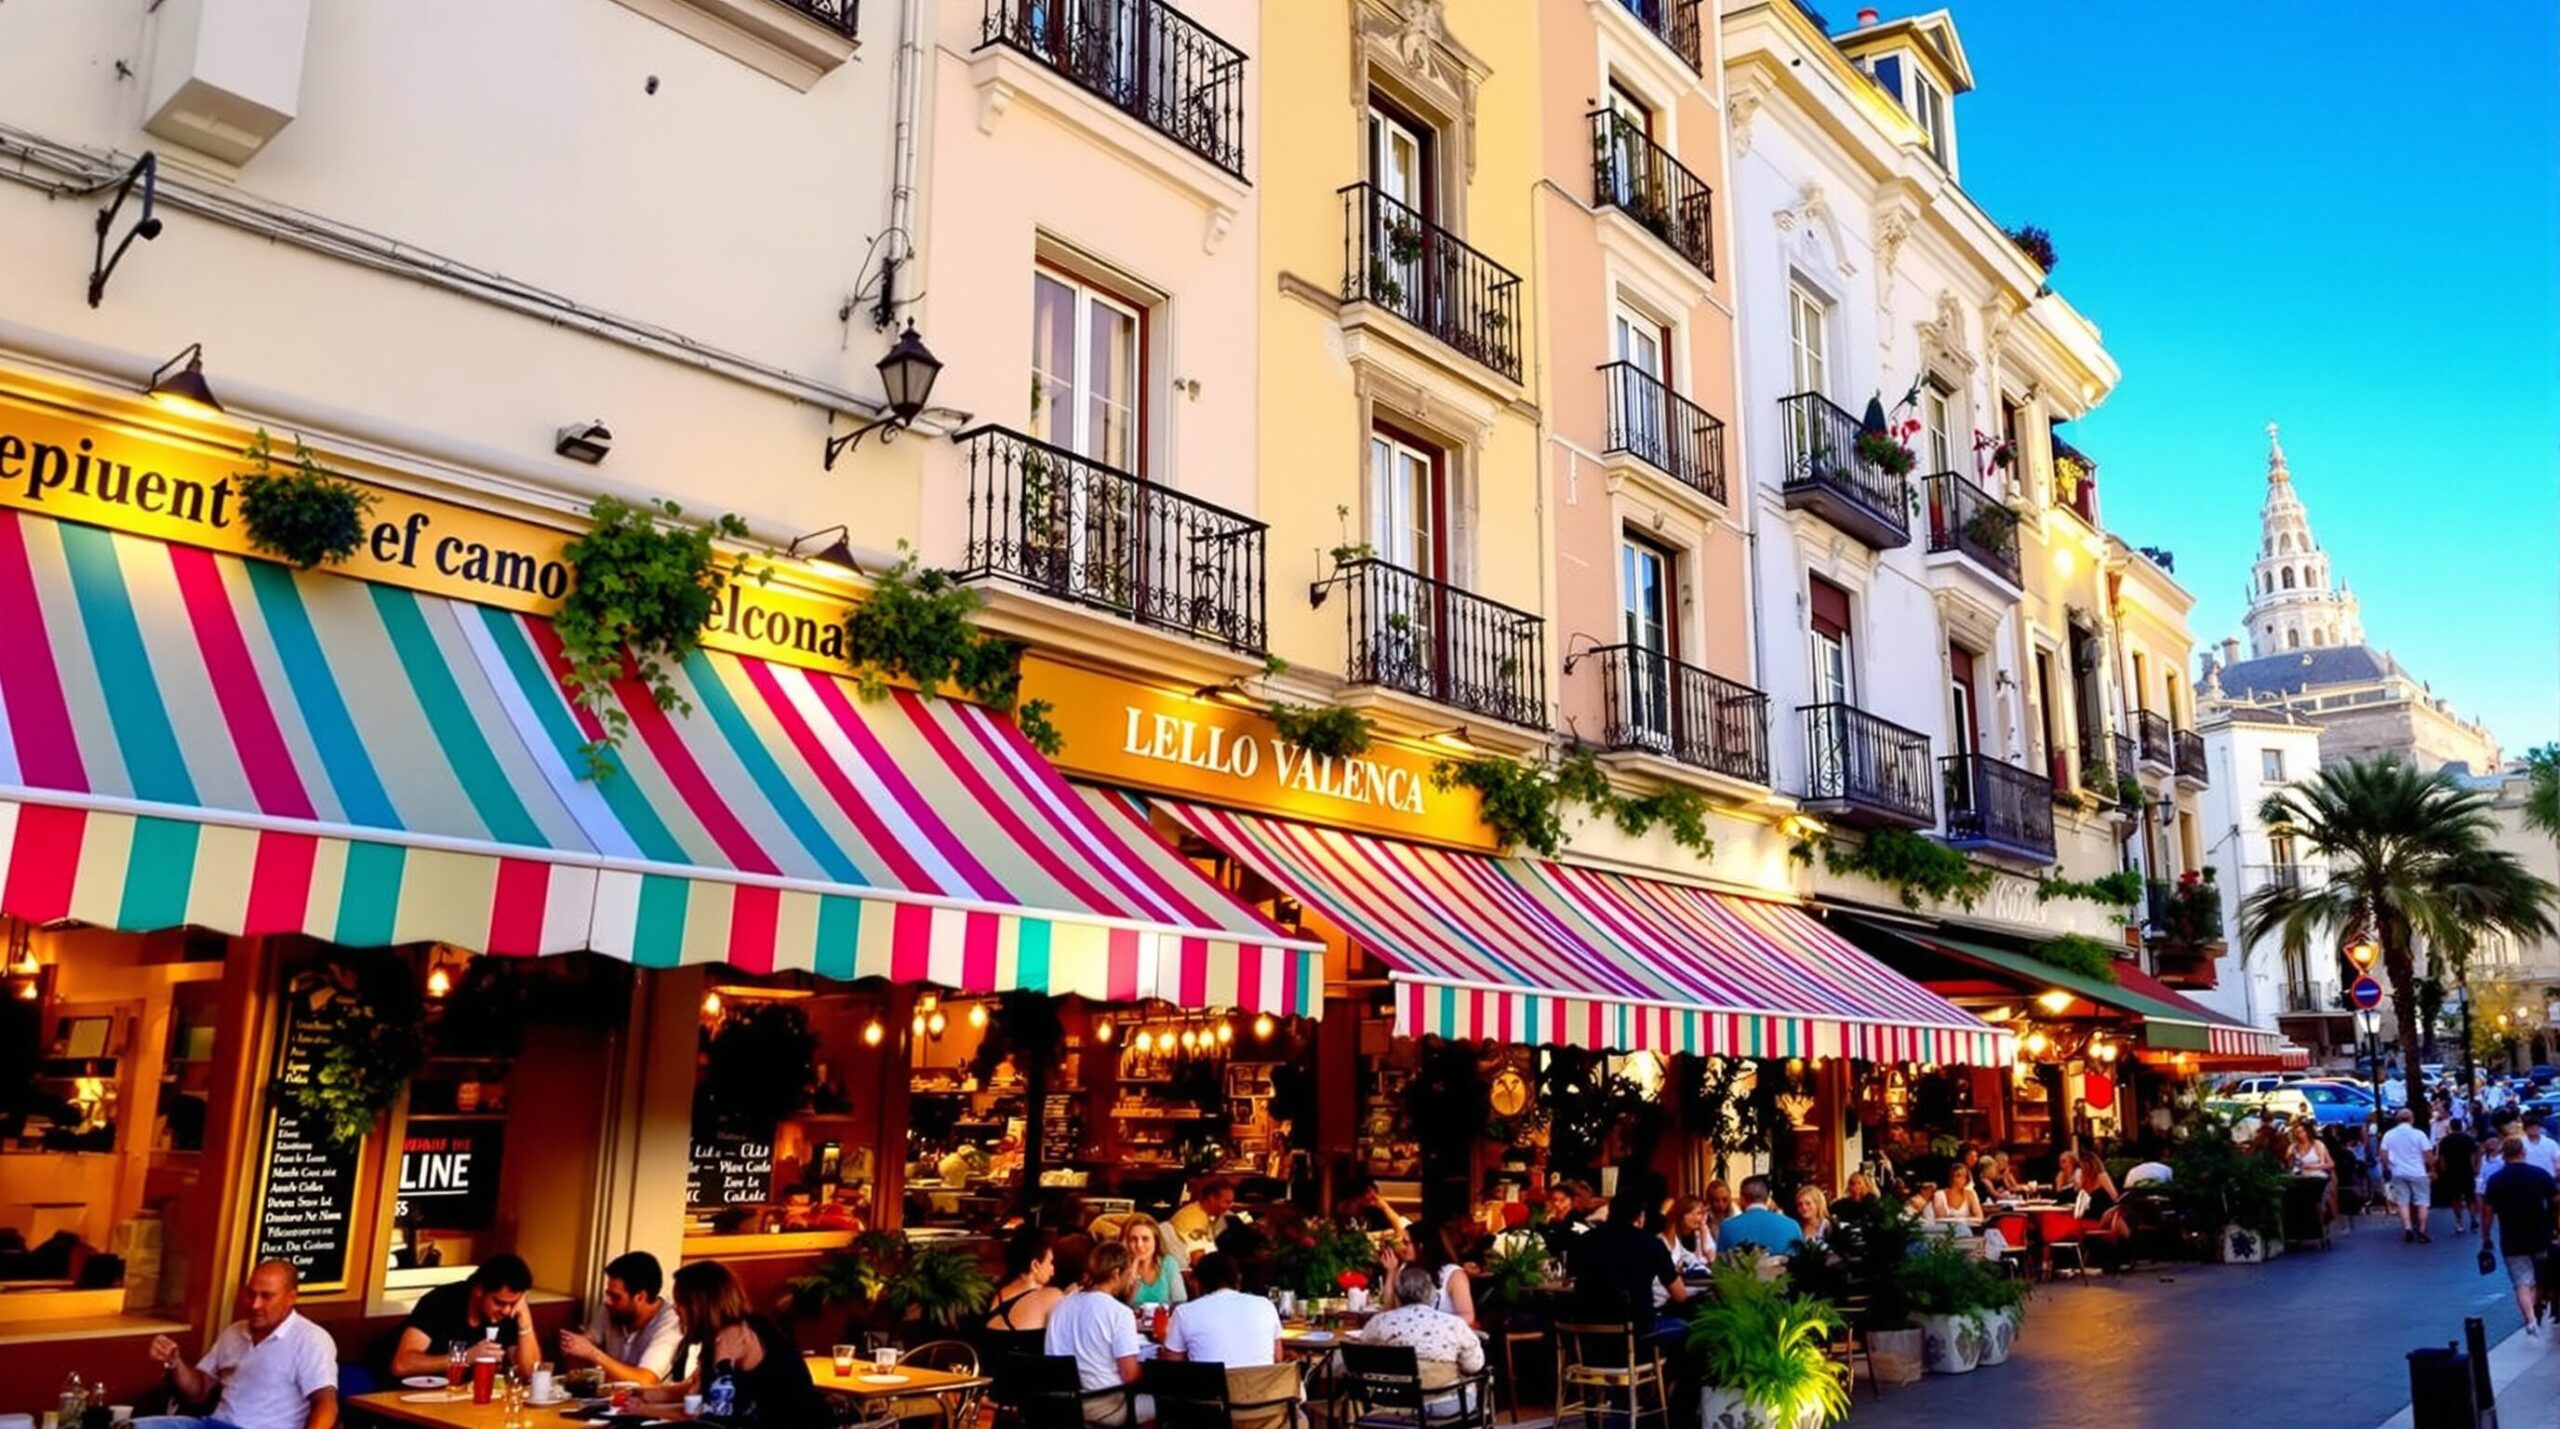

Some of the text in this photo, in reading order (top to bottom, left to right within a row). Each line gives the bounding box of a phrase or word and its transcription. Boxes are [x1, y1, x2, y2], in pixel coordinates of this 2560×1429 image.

[0, 435, 234, 528] epiuent
[435, 537, 568, 599] camo
[1123, 706, 1426, 814] LELLO VALENCA
[399, 1153, 472, 1189] LINE
